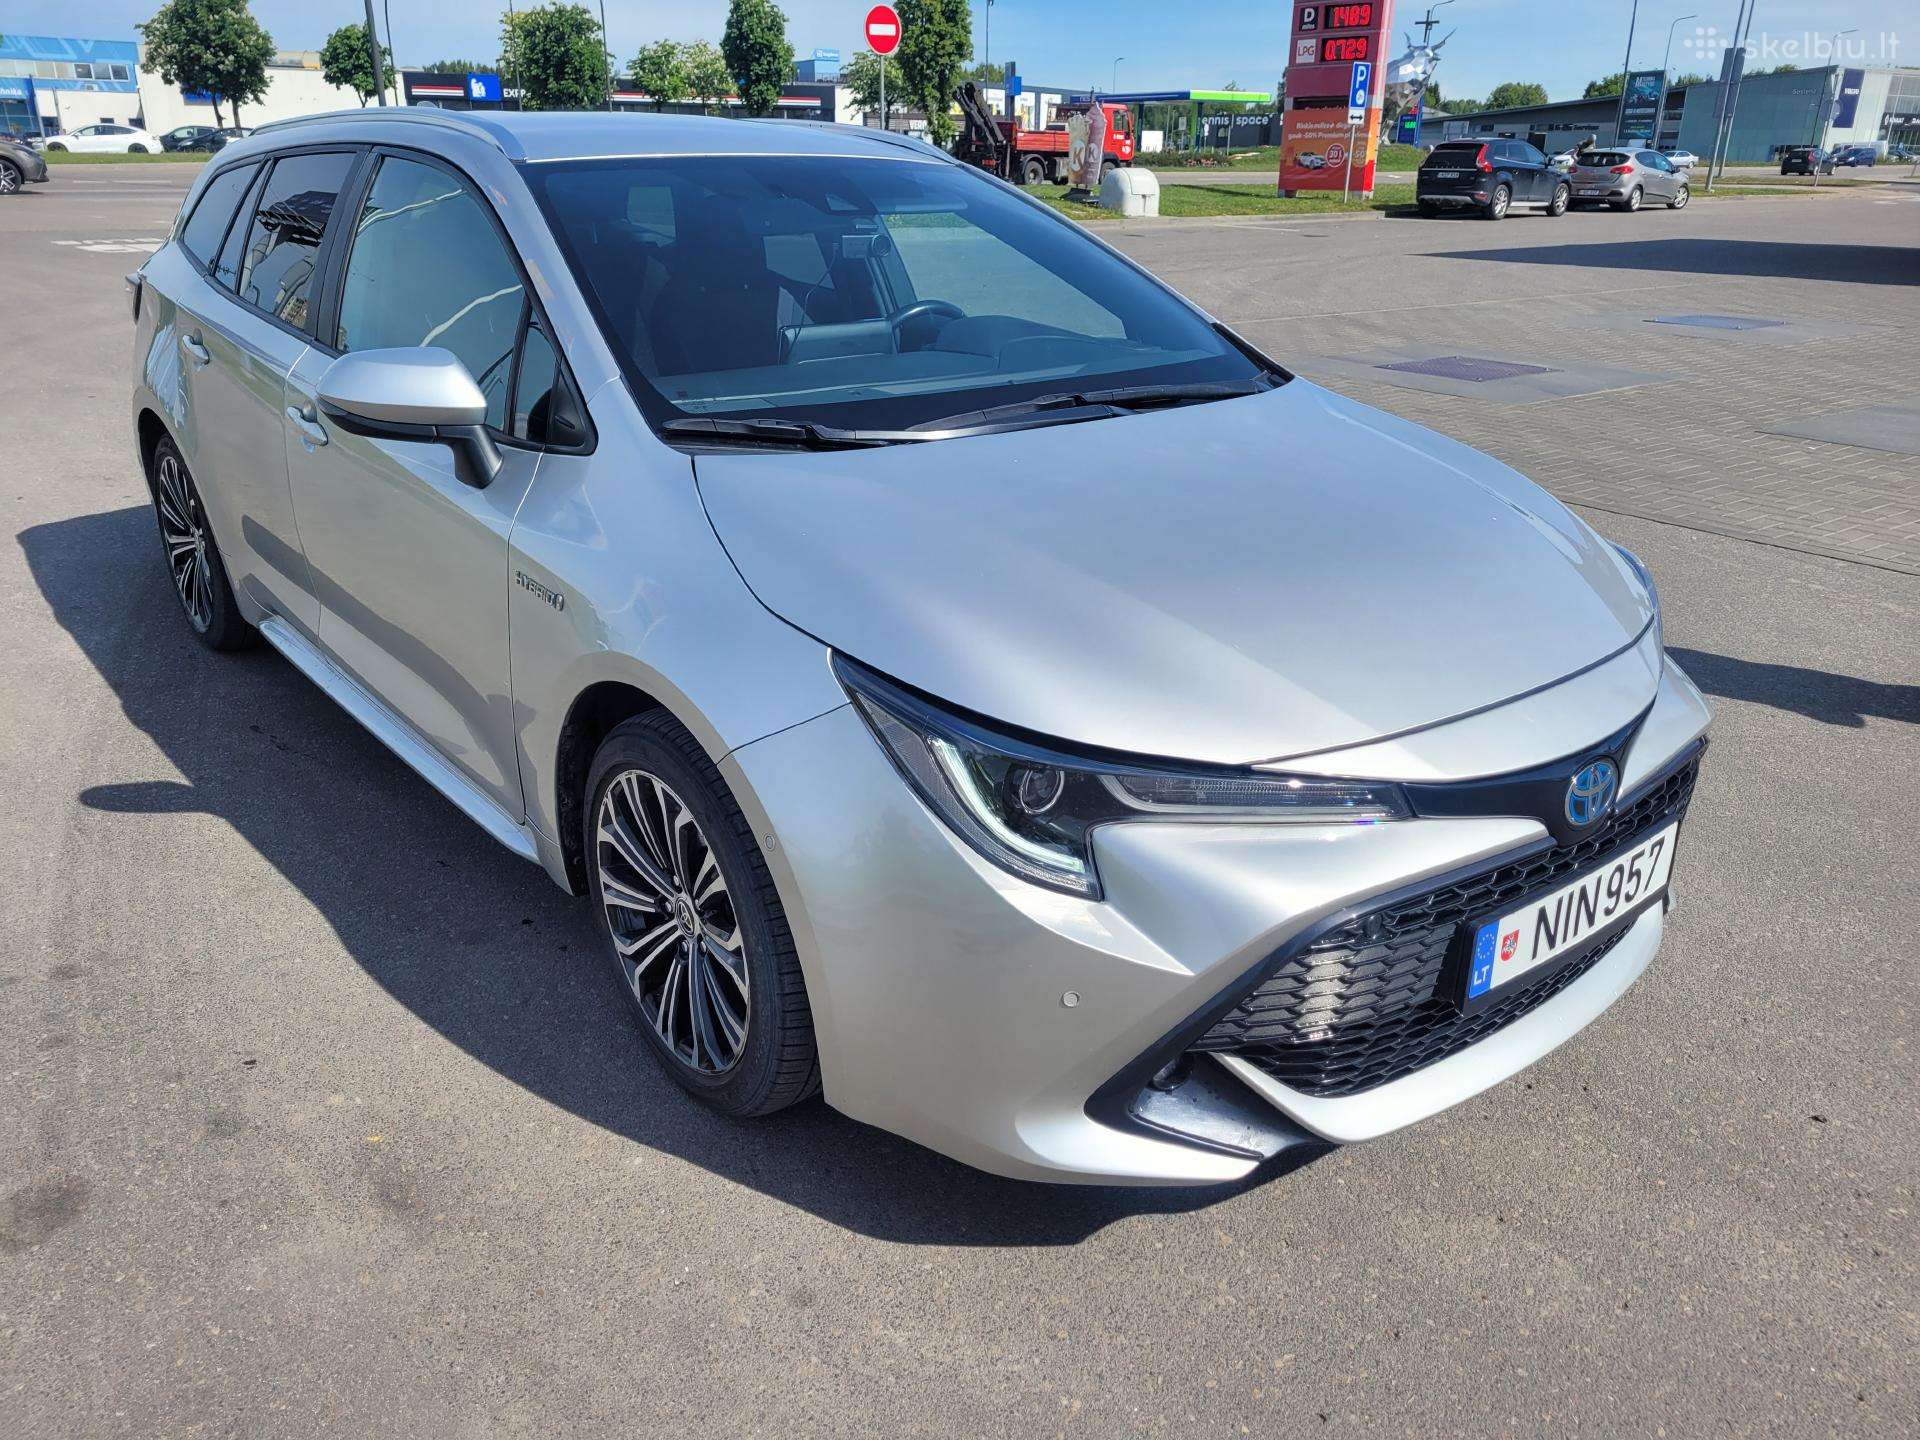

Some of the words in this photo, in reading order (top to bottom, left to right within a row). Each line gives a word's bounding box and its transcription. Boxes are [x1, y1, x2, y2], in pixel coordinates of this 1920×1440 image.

[1304, 8, 1315, 23] D
[1298, 45, 1315, 57] LPG
[1356, 66, 1367, 88] P
[1201, 114, 1230, 126] ennis
[1236, 115, 1269, 130] space
[1532, 836, 1666, 961] NIN957
[1474, 964, 1490, 985] LT
